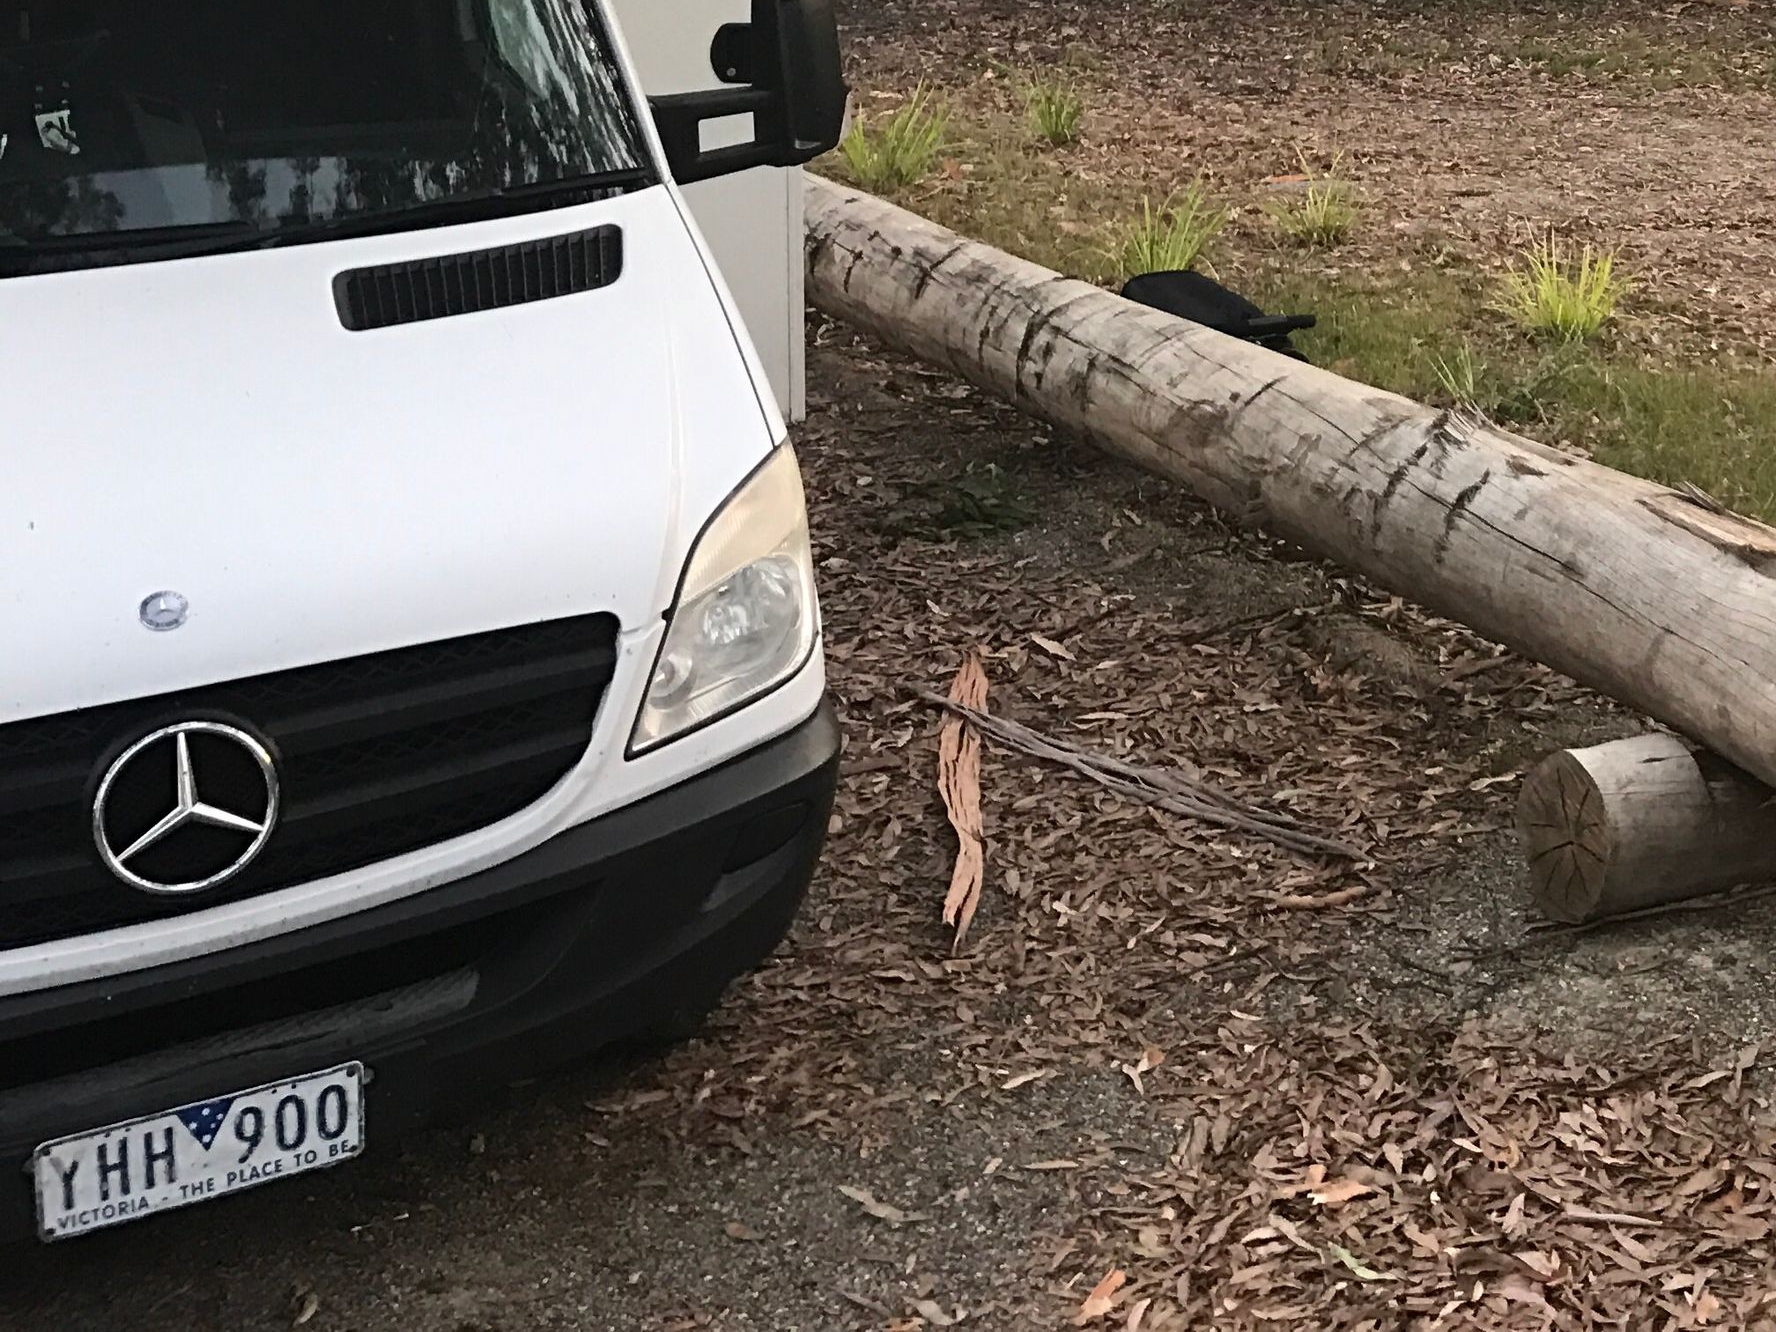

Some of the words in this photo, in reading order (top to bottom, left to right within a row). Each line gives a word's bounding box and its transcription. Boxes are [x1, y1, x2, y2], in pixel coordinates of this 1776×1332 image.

[53, 1126, 176, 1211] YHH
[234, 1084, 348, 1164] 900
[57, 1196, 149, 1230] VICTORIA
[179, 1177, 215, 1196] THE
[226, 1159, 284, 1187] PLACE
[294, 1149, 319, 1168] TO
[328, 1140, 349, 1157] BE
